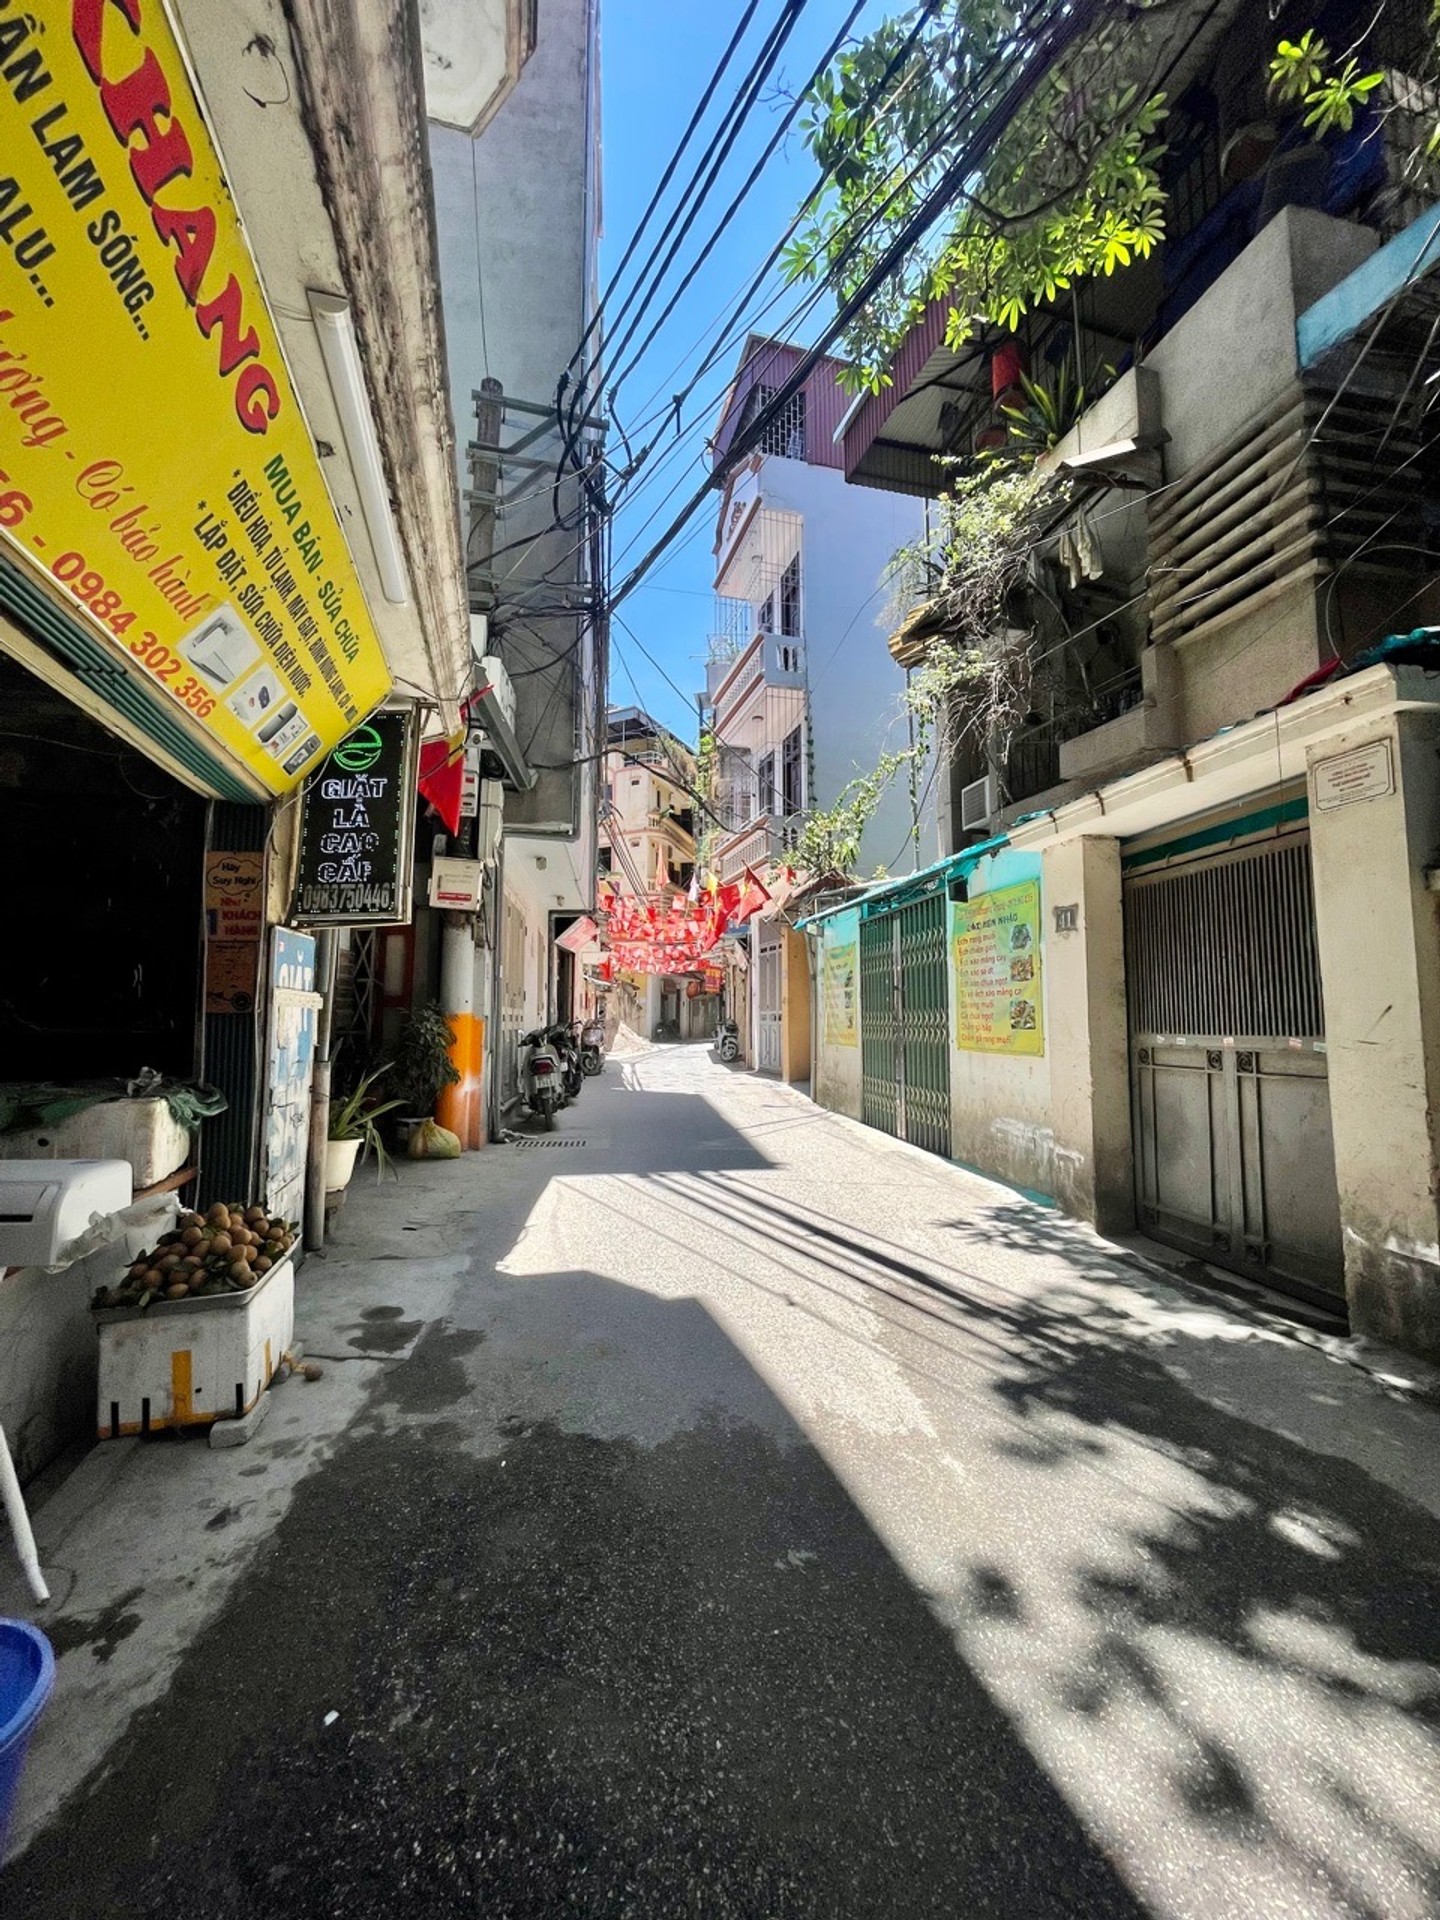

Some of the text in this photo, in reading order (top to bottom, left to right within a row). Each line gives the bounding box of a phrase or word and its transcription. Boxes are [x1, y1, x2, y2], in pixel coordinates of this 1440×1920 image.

[31, 102, 105, 212] LAM
[87, 210, 155, 341] SÓNG...
[76, 460, 135, 513] Có
[110, 504, 162, 562] bảo
[148, 554, 213, 622] hành
[193, 512, 229, 551] LẮP
[215, 548, 247, 593] ĐẶT,
[237, 583, 267, 619] SỬA
[255, 611, 284, 649] CHỮA
[272, 641, 298, 673] ĐIỆN
[226, 479, 262, 523] ĐIỀU
[262, 546, 289, 571] TỦ
[286, 594, 309, 623] MÁY
[263, 453, 302, 526] MUA
[292, 520, 324, 574] BÁN
[318, 580, 344, 623] SỬA
[334, 618, 360, 664] CHỮA
[51, 551, 138, 636] 0984
[129, 631, 182, 683] 302
[174, 677, 217, 718] 356
[333, 802, 370, 829] LÀ
